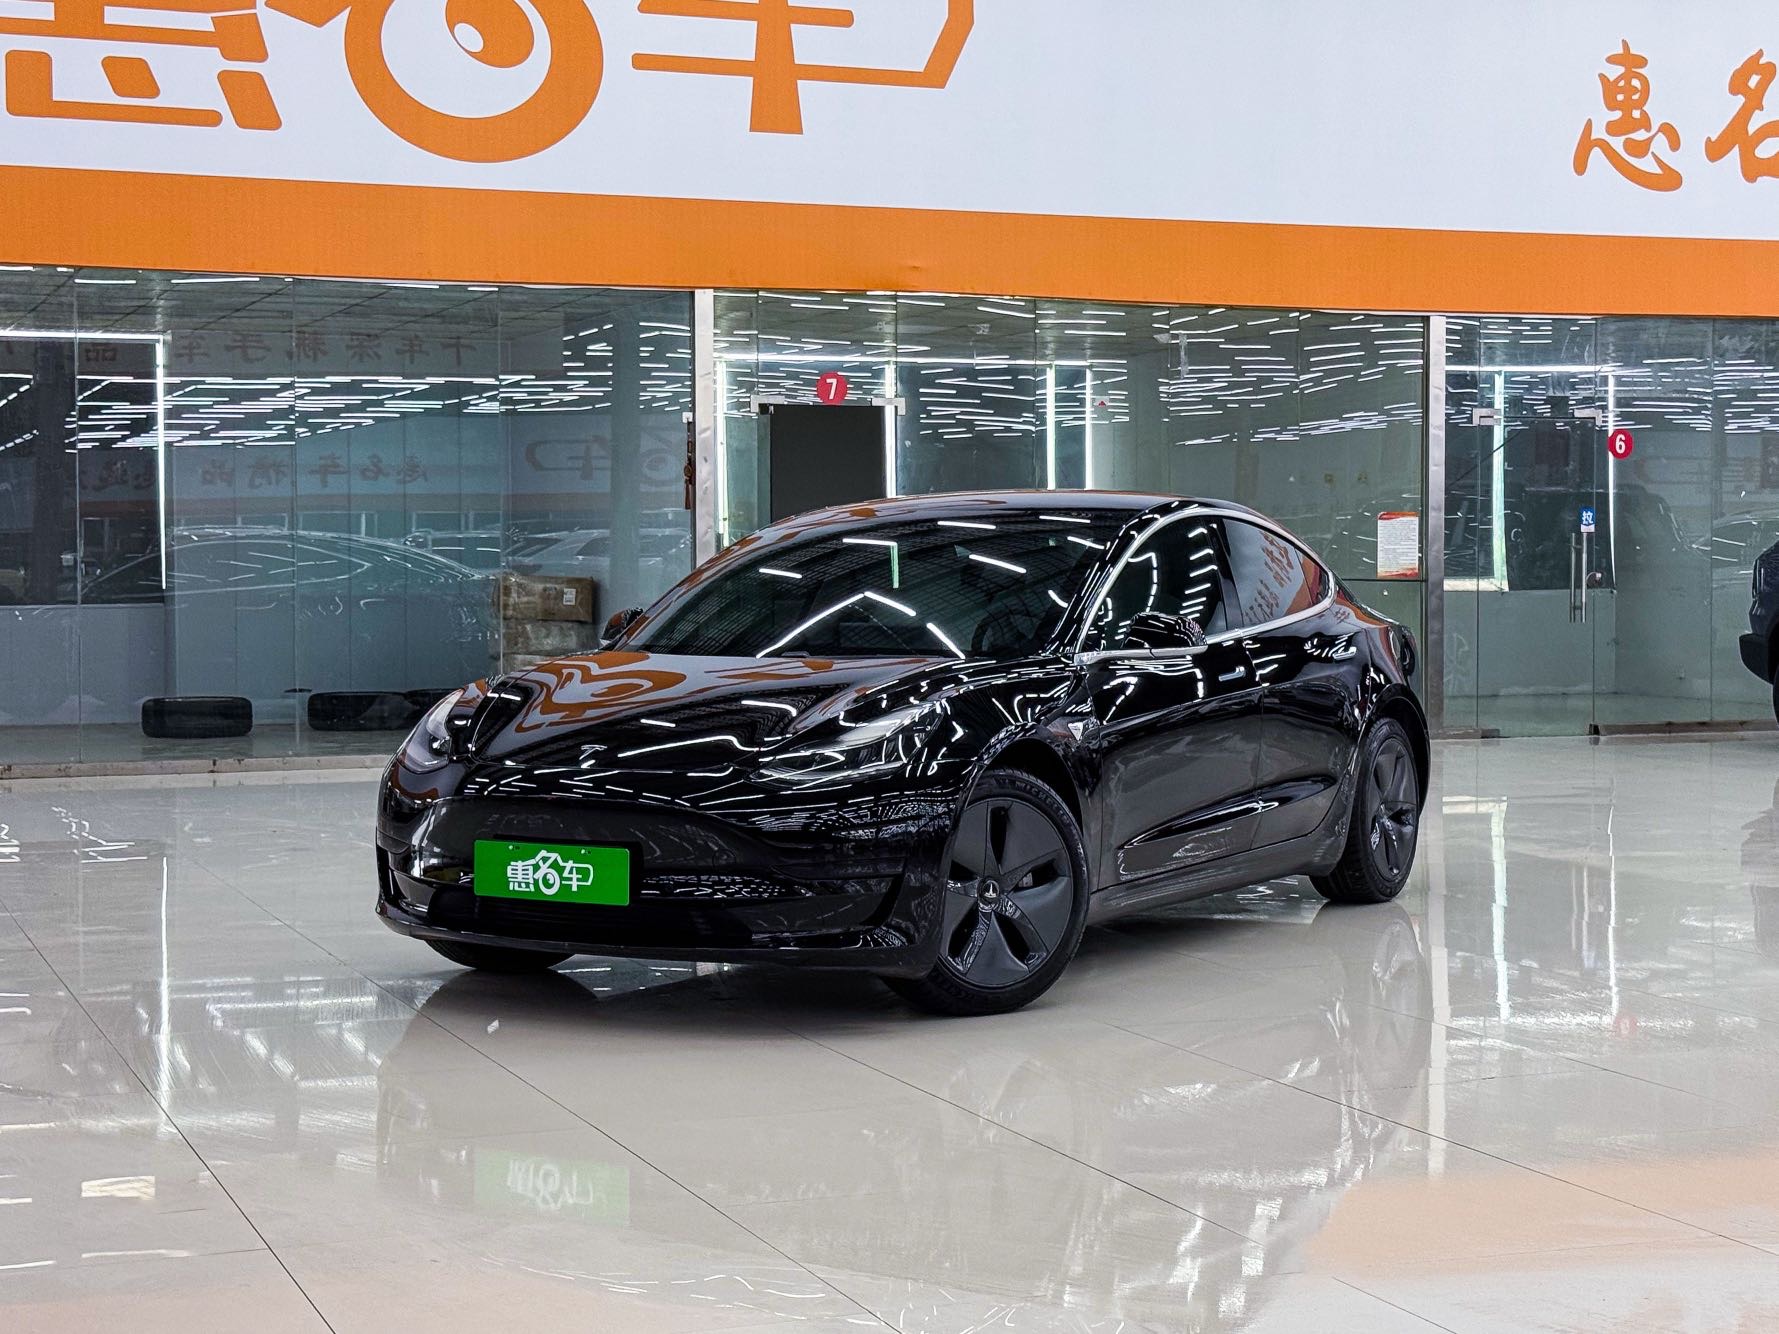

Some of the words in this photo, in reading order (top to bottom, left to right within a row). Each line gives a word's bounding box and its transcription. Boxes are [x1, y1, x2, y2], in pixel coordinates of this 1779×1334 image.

[826, 378, 837, 400] 7
[1615, 433, 1626, 454] 6
[506, 849, 594, 895] 惠名车
